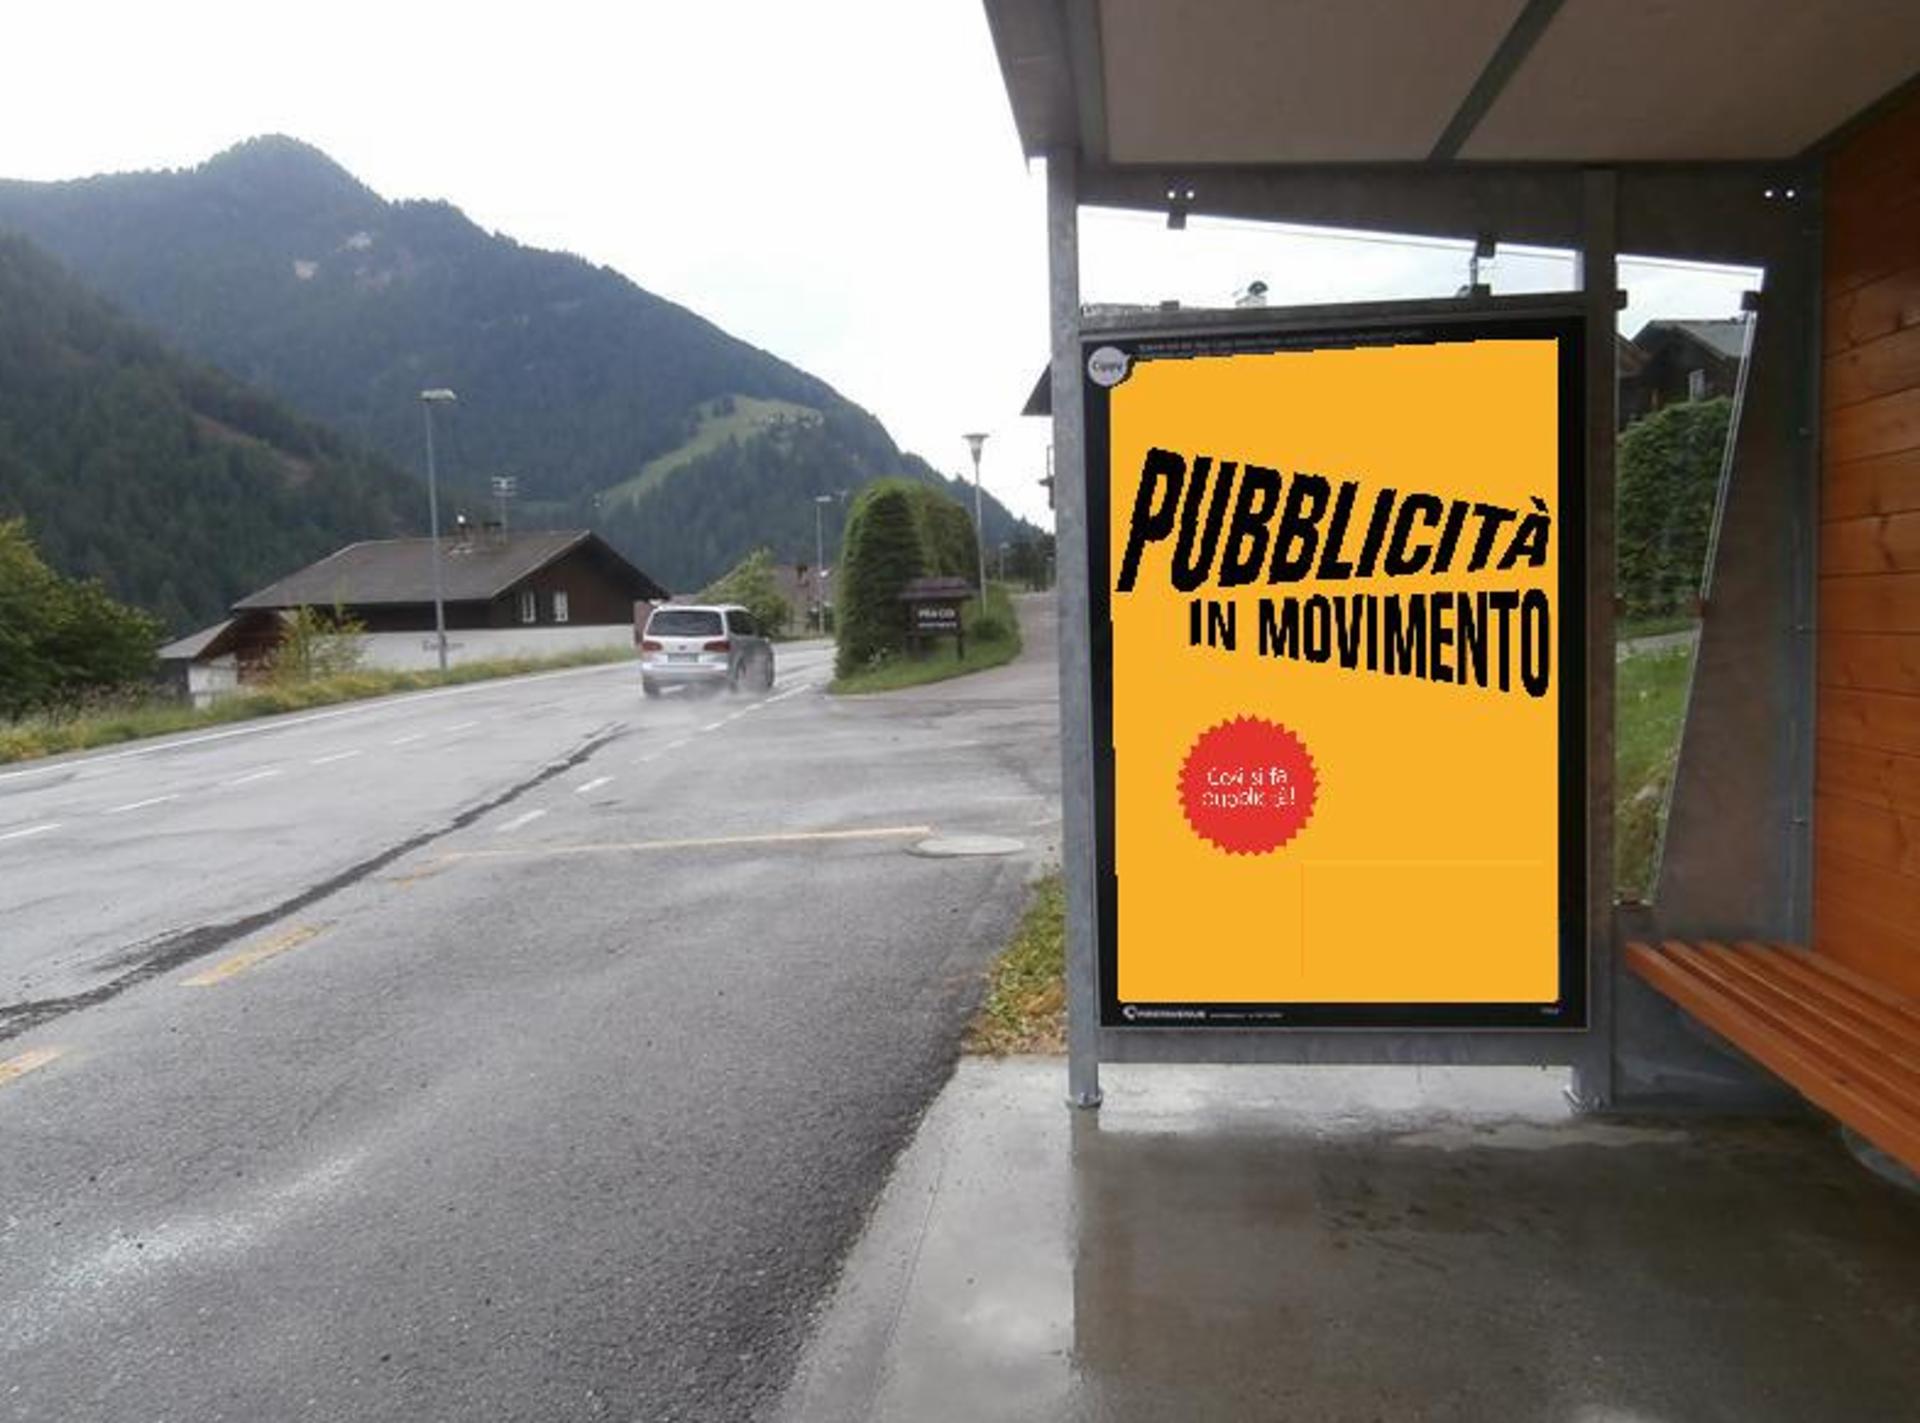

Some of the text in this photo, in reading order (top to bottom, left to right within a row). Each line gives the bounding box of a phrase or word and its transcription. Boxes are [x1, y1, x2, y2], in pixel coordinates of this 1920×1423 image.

[1117, 448, 1551, 593] PUBBLICITÀ
[1191, 589, 1550, 698] IN MOVIMENTO
